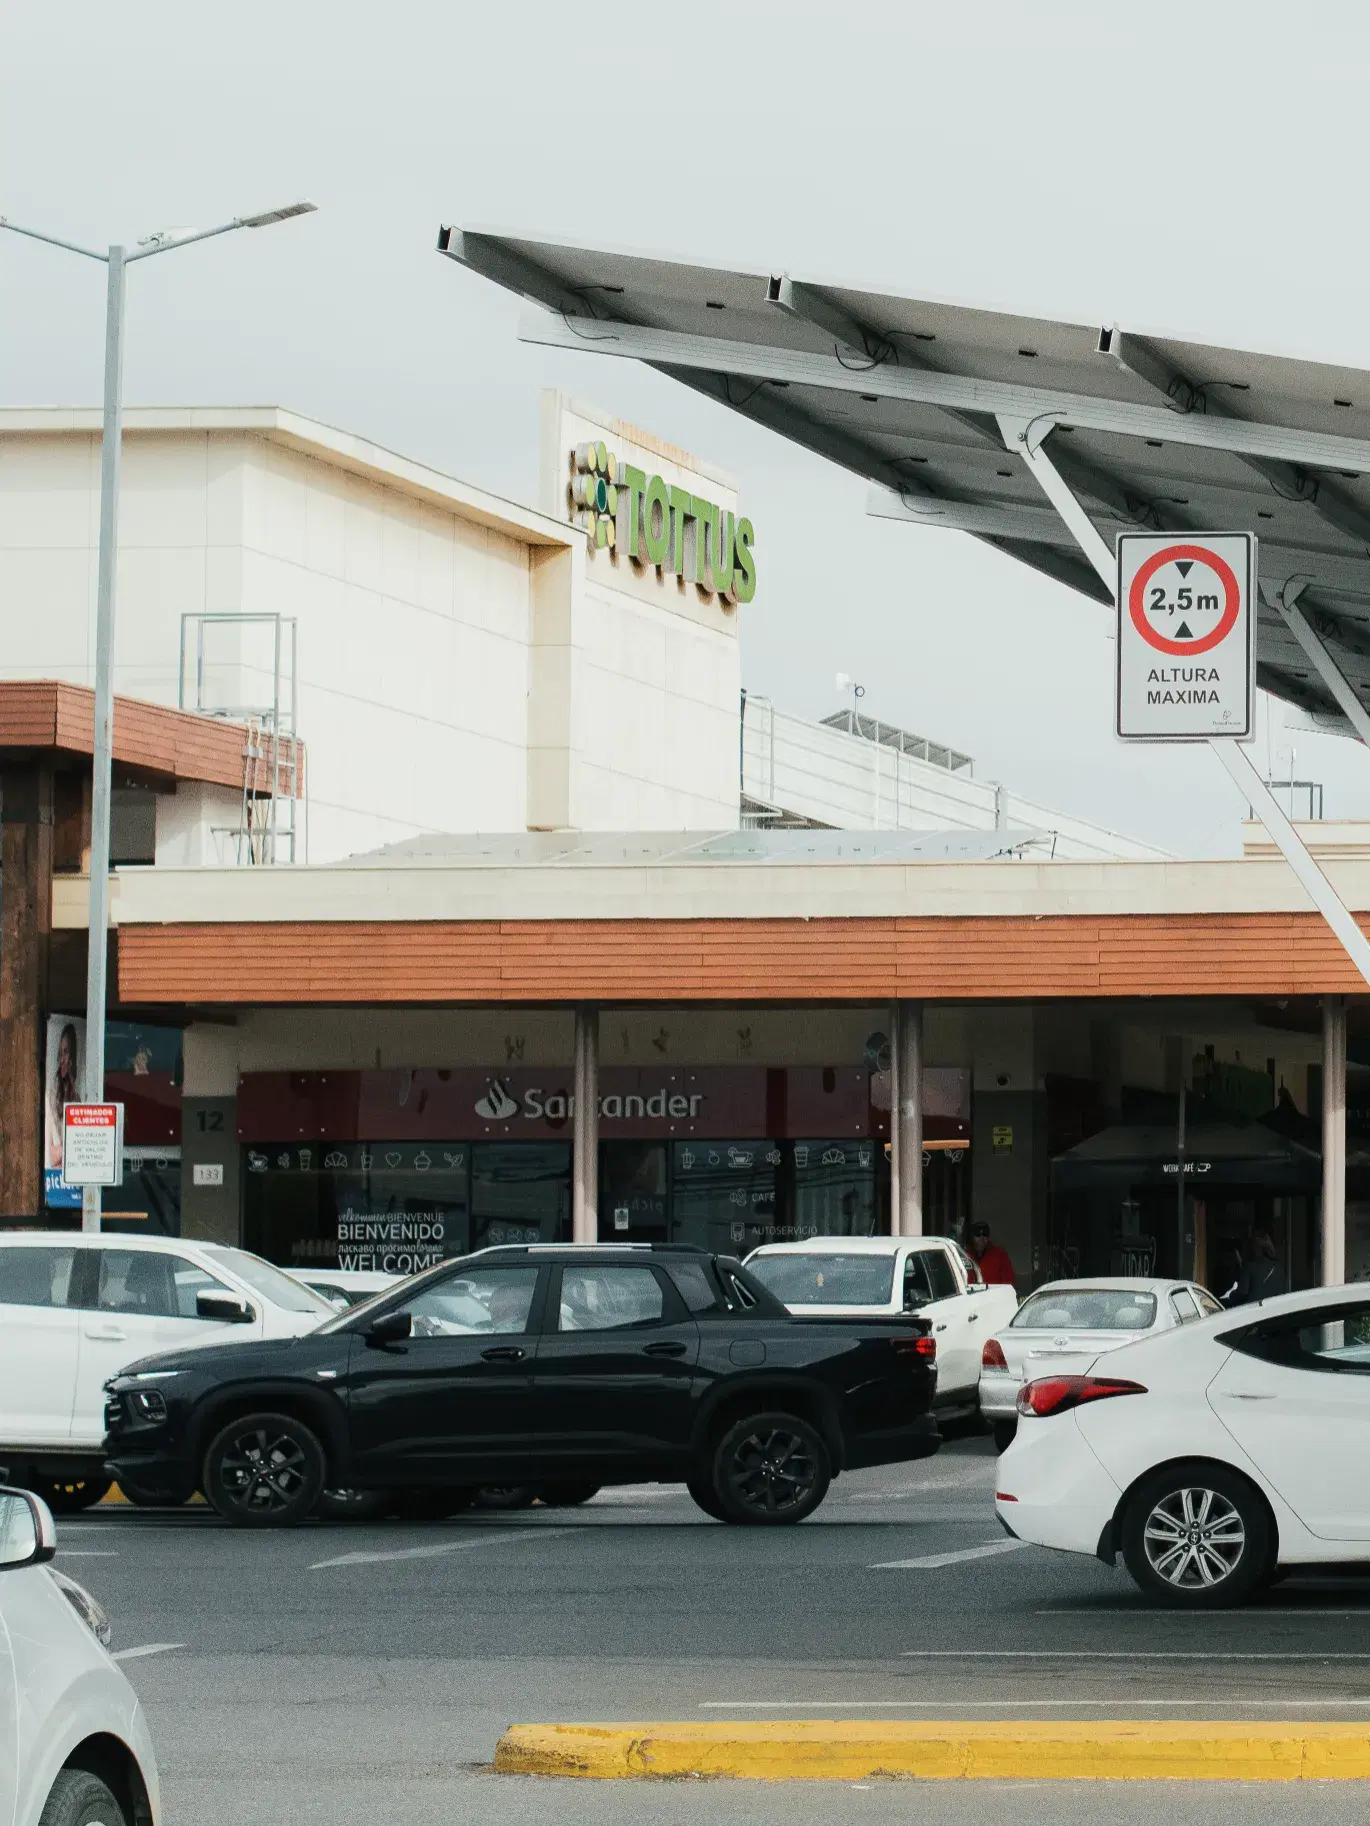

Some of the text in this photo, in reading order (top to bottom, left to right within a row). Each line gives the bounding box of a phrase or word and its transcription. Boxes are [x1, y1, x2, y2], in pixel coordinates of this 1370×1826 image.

[617, 463, 756, 603] TOTTUS
[1147, 668, 1220, 682] ALTURA
[1147, 690, 1220, 704] MAXIMA
[523, 1088, 703, 1119] Saander
[69, 1108, 113, 1116] ESTIMADOS
[196, 1110, 225, 1131] 12
[1163, 1162, 1194, 1173] WORK AFÉ
[751, 1190, 775, 1202] CAFÉ
[387, 1213, 444, 1223] BIENVENUE
[338, 1224, 444, 1240] BIENVENIDO
[751, 1226, 818, 1236] AUTOSERVICIO
